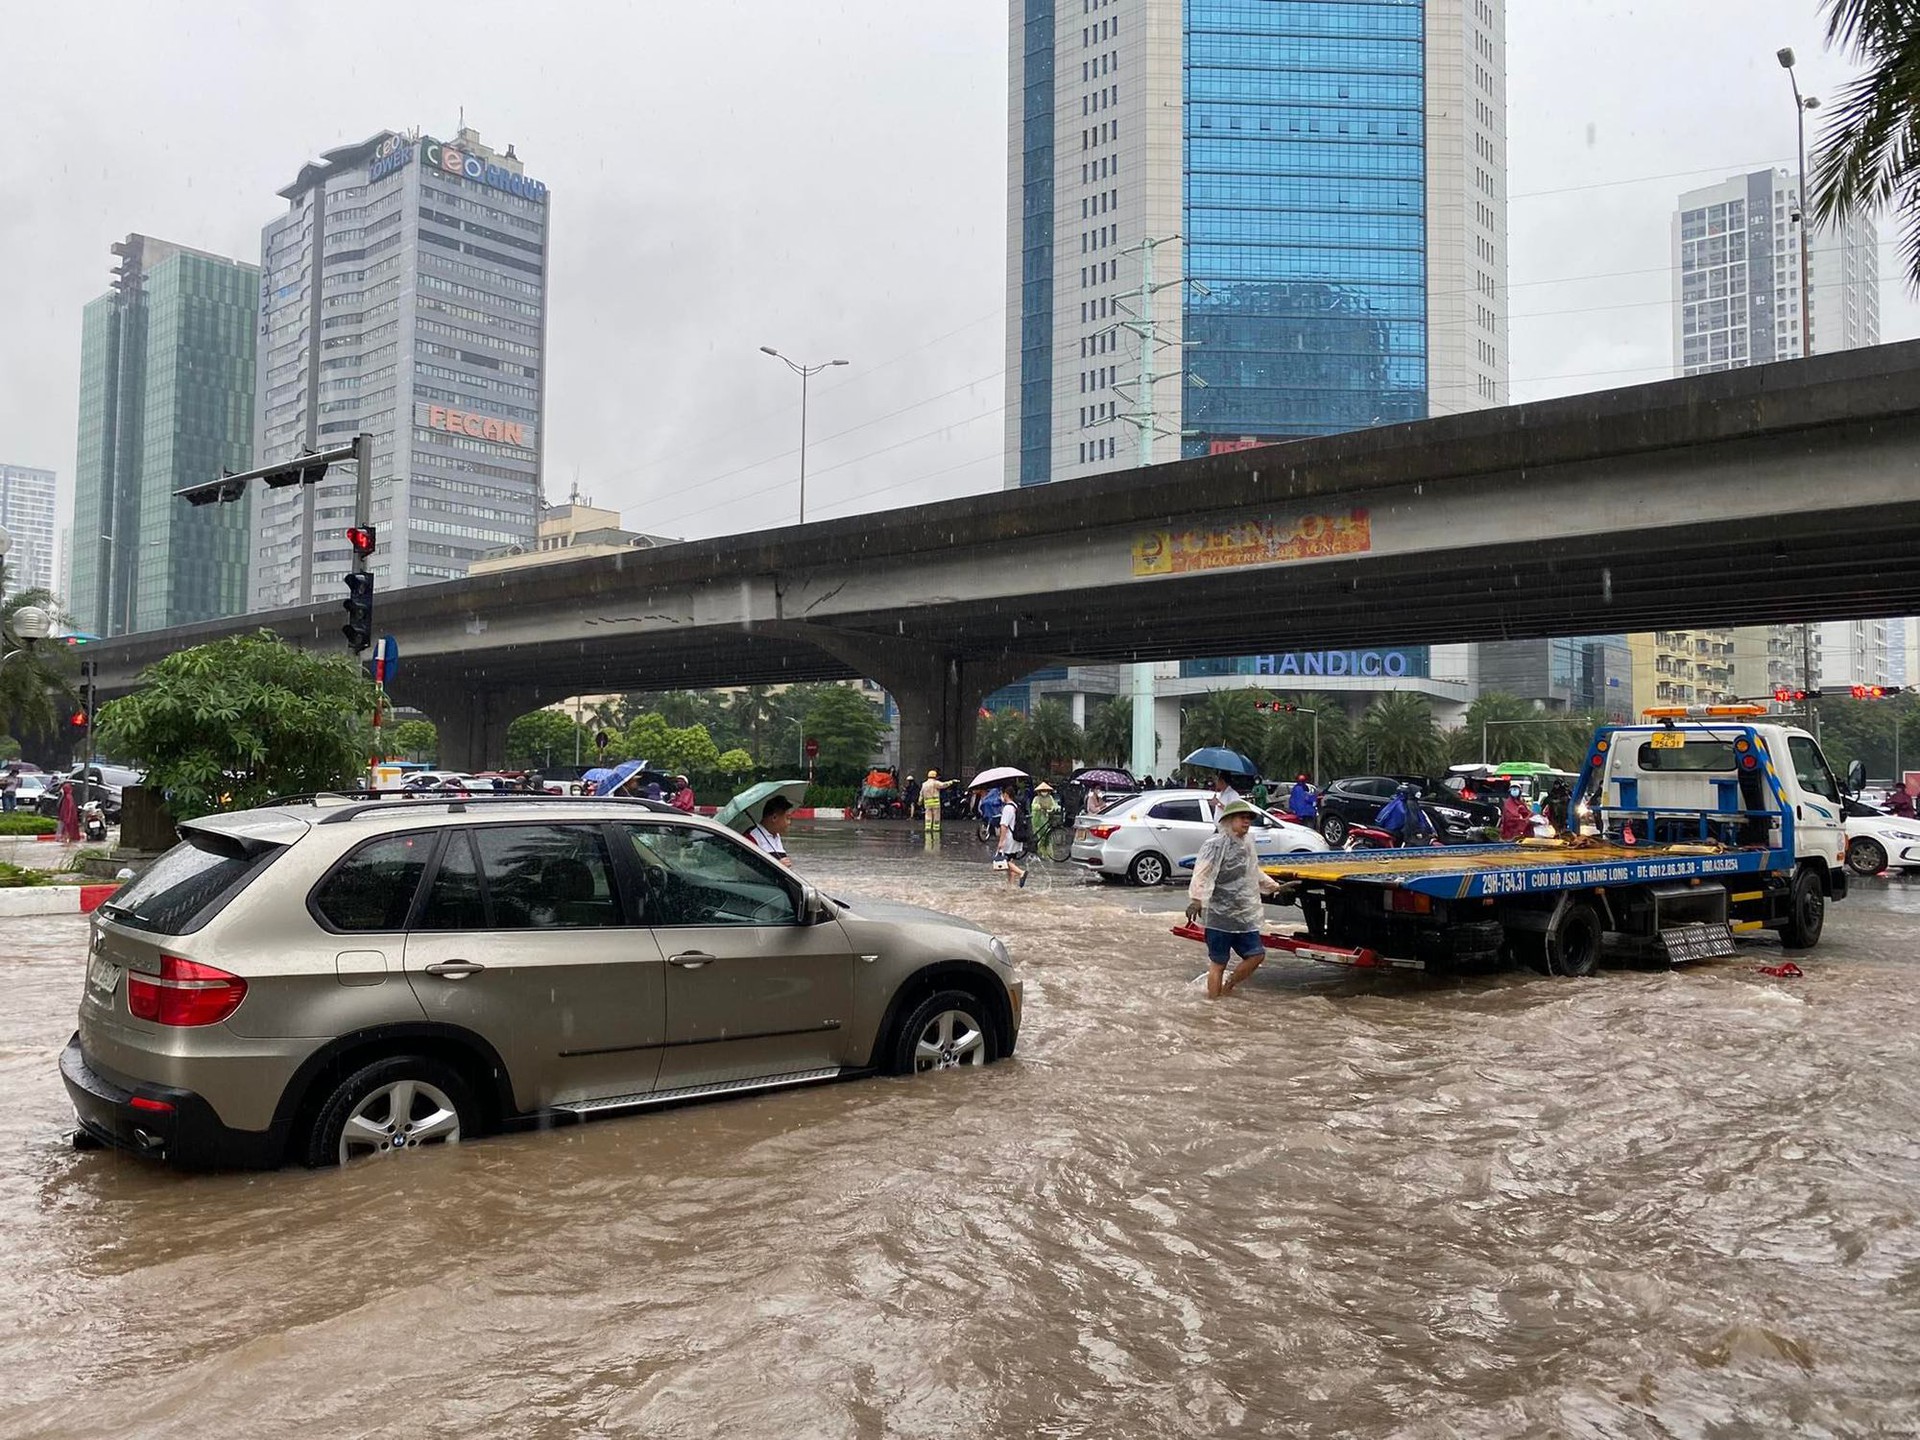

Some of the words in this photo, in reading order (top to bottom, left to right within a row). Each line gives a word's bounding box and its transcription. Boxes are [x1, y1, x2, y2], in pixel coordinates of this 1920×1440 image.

[368, 146, 410, 179] TOWER
[486, 163, 546, 200] GROUP
[1255, 650, 1407, 677] HANDICO
[1482, 872, 1527, 894] 29H-754.31
[1550, 869, 1561, 888] HỘ
[1563, 871, 1581, 885] ASIA
[1583, 867, 1607, 883] THĂNG
[1609, 867, 1628, 881] LONG
